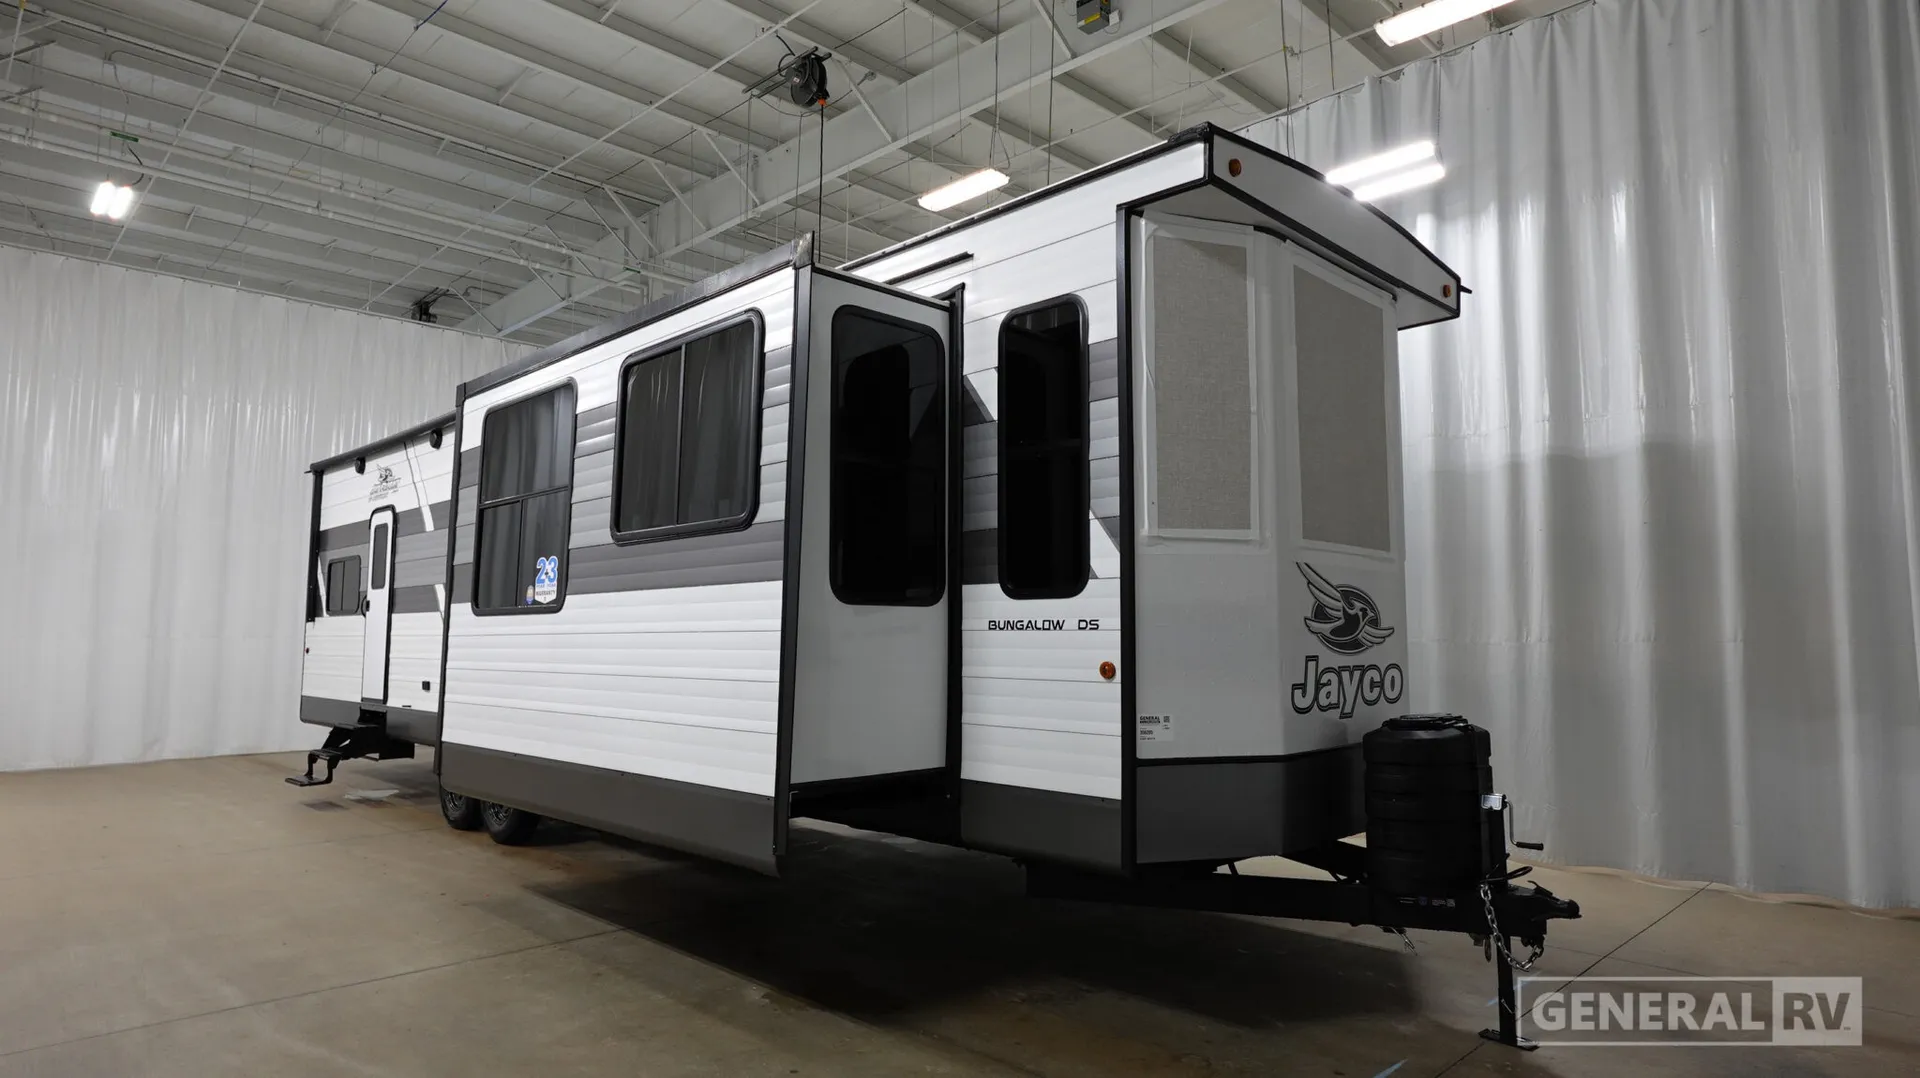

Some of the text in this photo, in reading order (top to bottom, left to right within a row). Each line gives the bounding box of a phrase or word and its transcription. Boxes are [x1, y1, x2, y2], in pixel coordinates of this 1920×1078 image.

[988, 619, 1100, 631] BUNGALOW DS
[1291, 655, 1403, 719] Jayco
